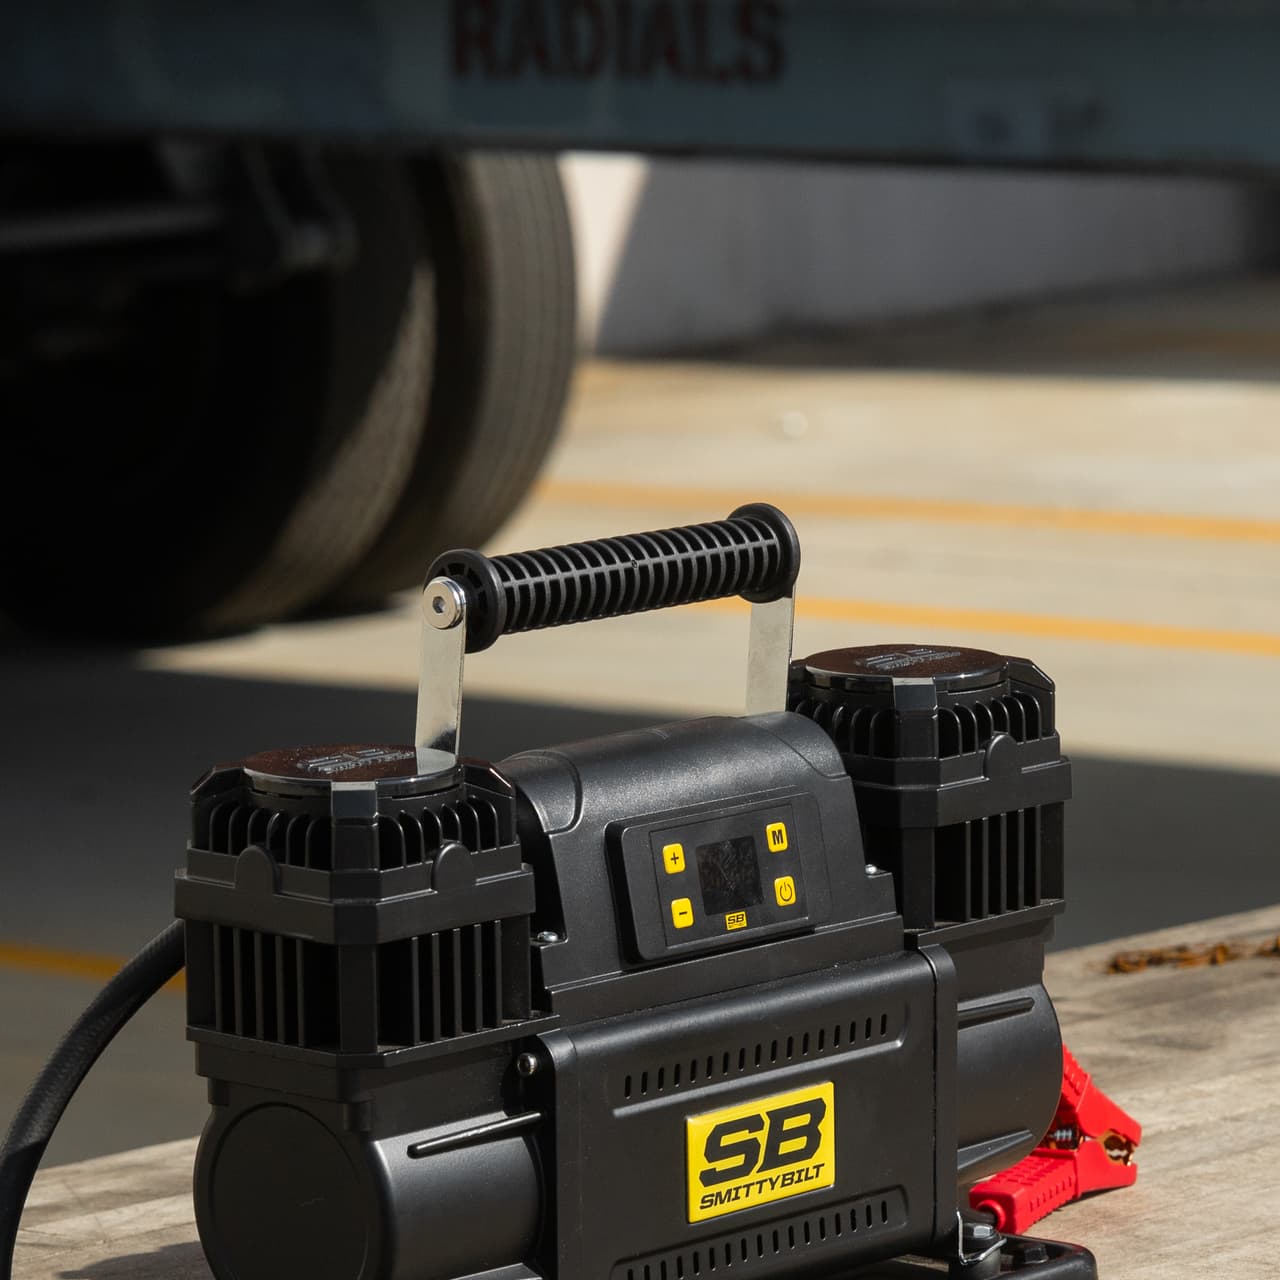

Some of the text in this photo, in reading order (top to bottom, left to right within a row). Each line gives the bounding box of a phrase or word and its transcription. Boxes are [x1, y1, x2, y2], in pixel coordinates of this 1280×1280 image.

[451, 0, 787, 83] RADIALS
[772, 829, 784, 845] M
[728, 914, 745, 925] SB
[699, 1097, 827, 1188] SB
[699, 1163, 825, 1210] SMITTYBILT
